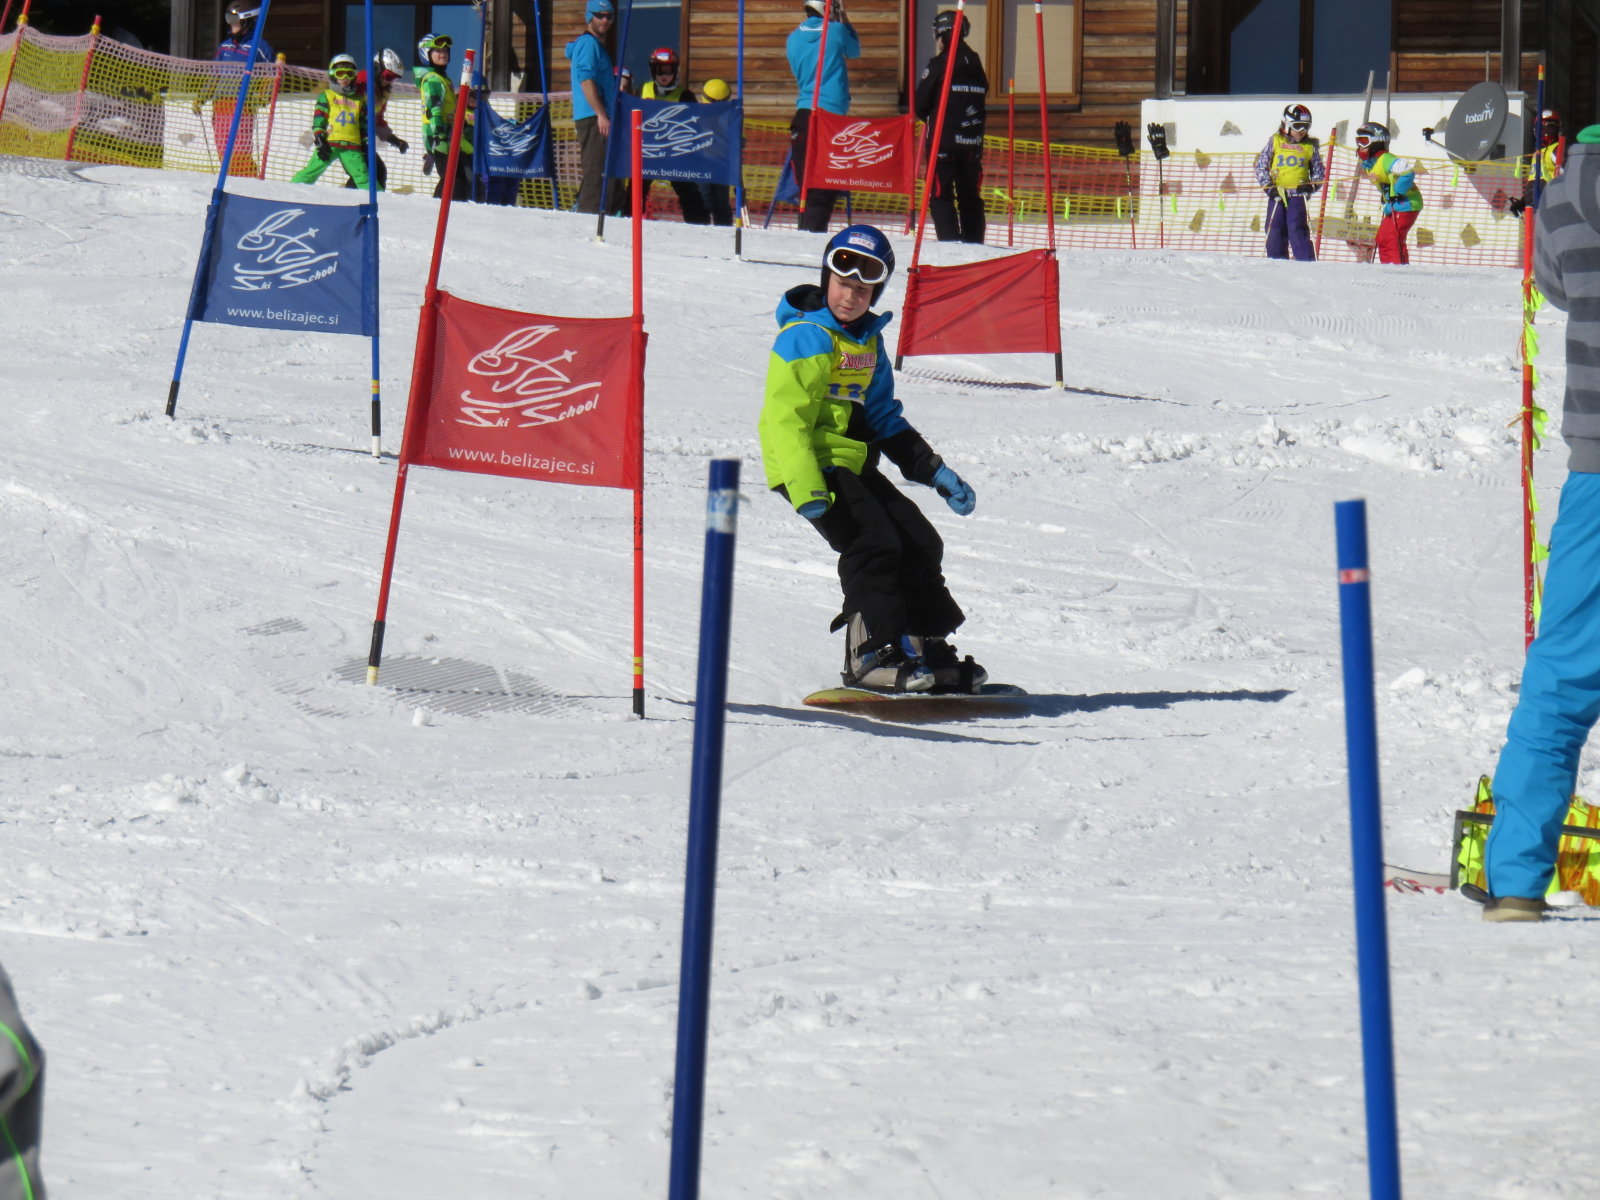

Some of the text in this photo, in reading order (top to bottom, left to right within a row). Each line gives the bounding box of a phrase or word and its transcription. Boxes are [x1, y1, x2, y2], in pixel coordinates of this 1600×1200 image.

[336, 110, 356, 127] 41
[1465, 108, 1494, 124] totalTV
[642, 138, 713, 158] Ski School
[828, 150, 893, 169] Ski School
[1277, 154, 1306, 168] 101
[642, 169, 712, 179] ww.belizajec.si
[825, 177, 893, 188] www.belizajec.si
[230, 261, 338, 291] Ski School
[227, 307, 339, 325] www.belizajec.si
[455, 394, 599, 428] Ski School
[448, 447, 595, 475] www.belizajec.si
